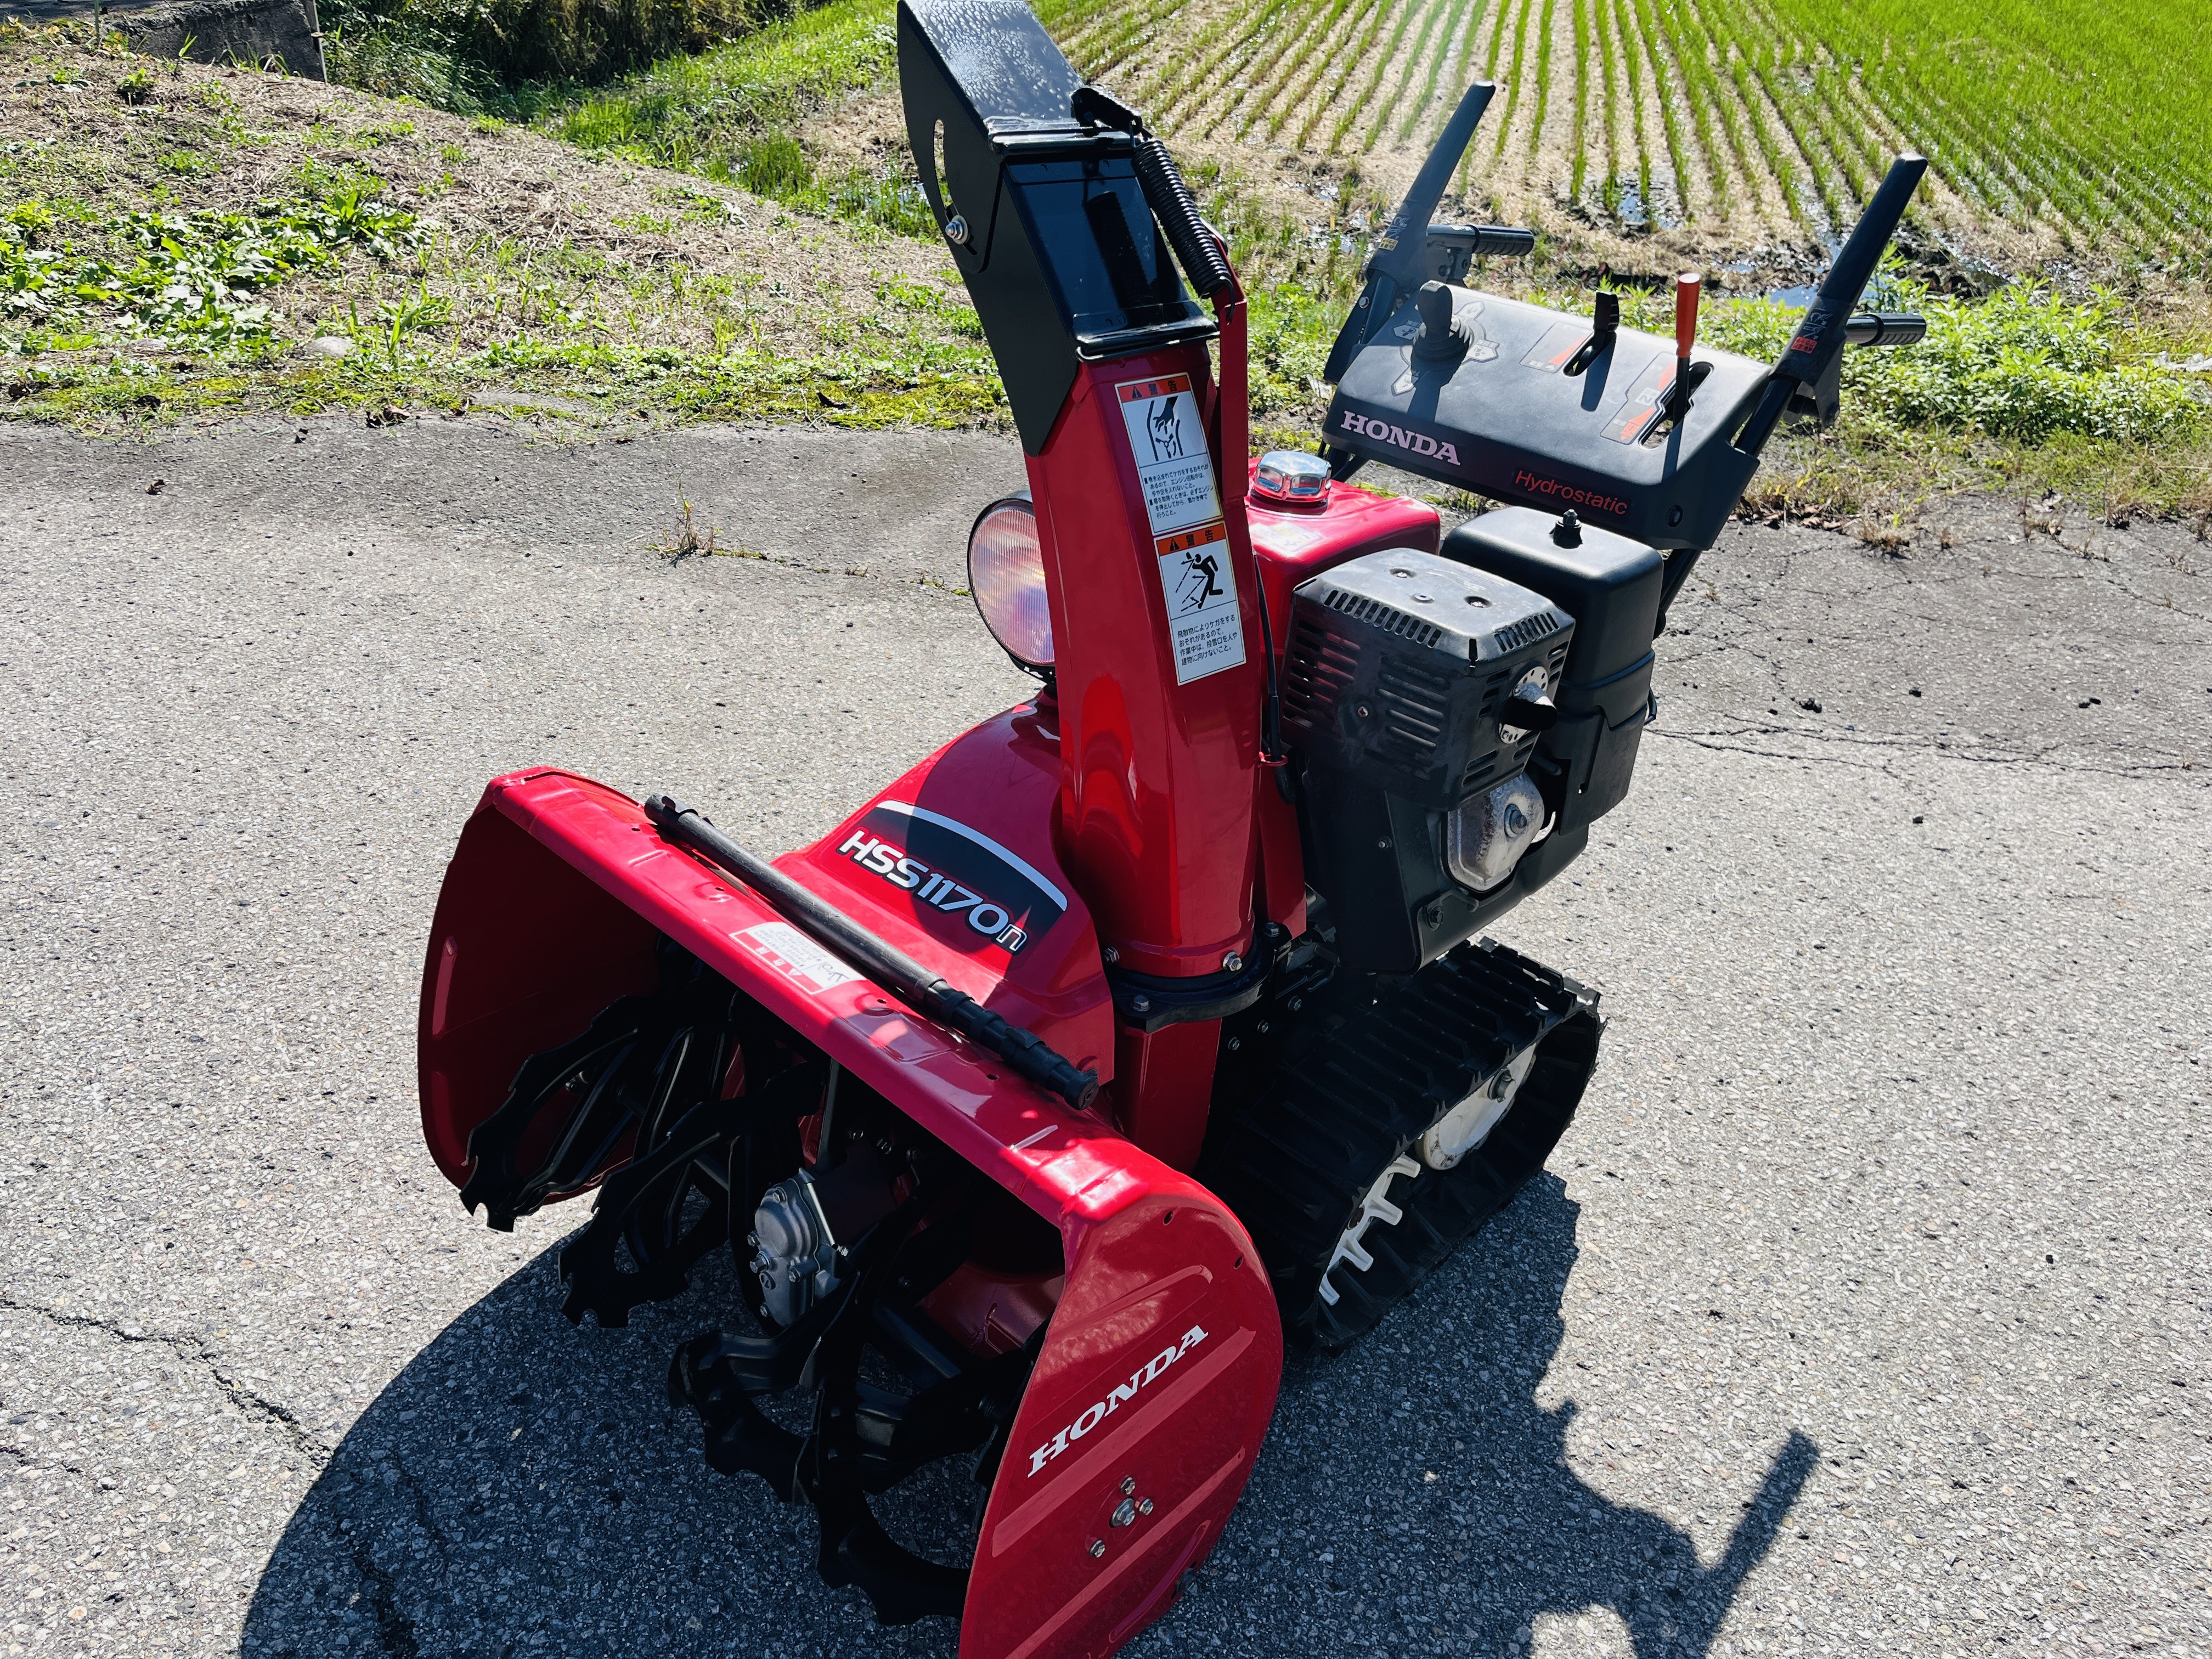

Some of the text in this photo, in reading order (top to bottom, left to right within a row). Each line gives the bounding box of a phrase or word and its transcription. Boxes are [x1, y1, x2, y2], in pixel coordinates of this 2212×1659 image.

[1341, 410, 1461, 466] HONDA
[1152, 483, 1195, 497] 手や足を入れないこと。
[1515, 470, 1628, 515] Hydrostatic
[1156, 510, 1176, 519] 行うこと。
[1186, 530, 1214, 546] 警告
[1178, 614, 1235, 639] 飛散物によりケガをする
[1180, 628, 1223, 647] おそれがあるので、
[1182, 645, 1231, 666] 建物に向けないこと。
[839, 830, 1027, 951] HSS1170n
[1028, 1325, 1209, 1477] HONDA
